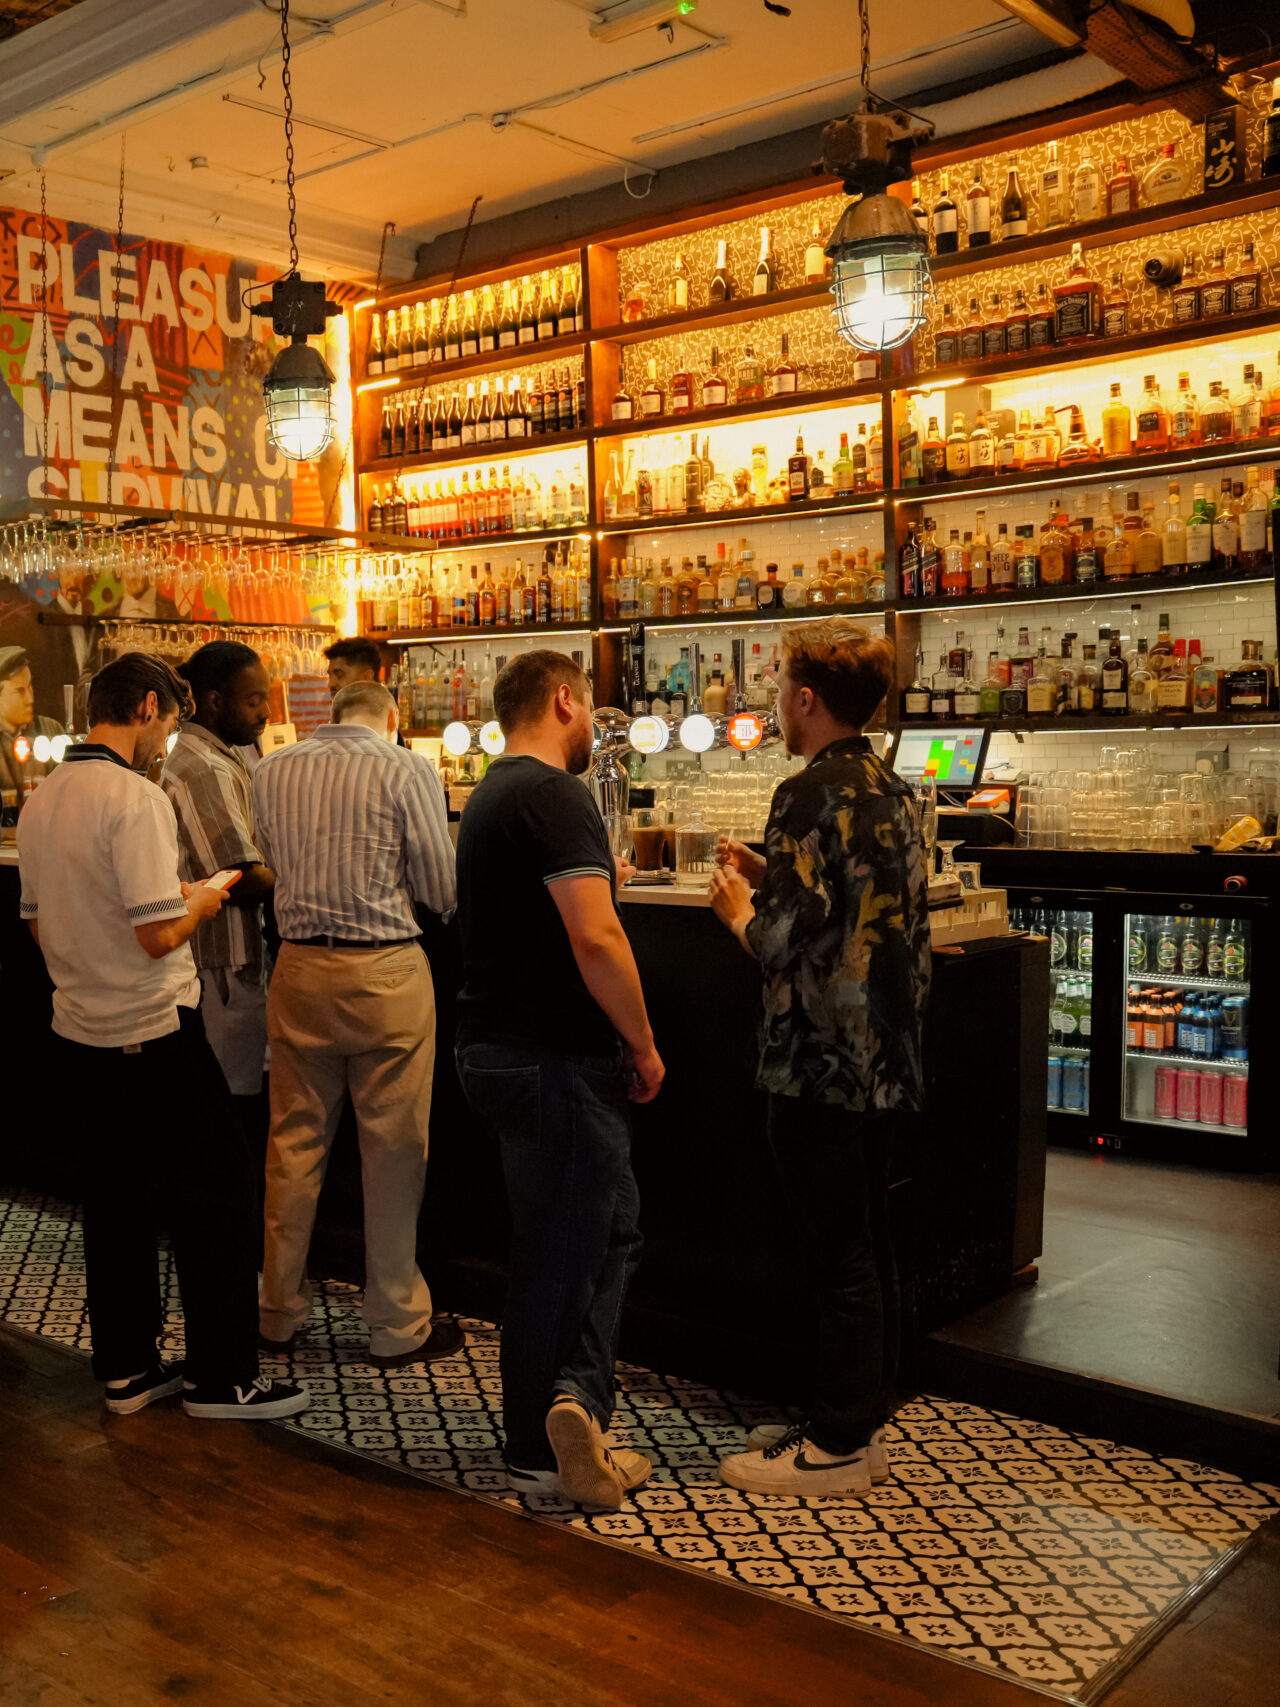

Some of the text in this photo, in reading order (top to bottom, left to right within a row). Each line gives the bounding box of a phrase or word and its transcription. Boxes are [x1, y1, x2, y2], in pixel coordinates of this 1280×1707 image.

[18, 234, 290, 343] PLEASU
[21, 312, 160, 393] AS A
[21, 389, 227, 473] MEANS
